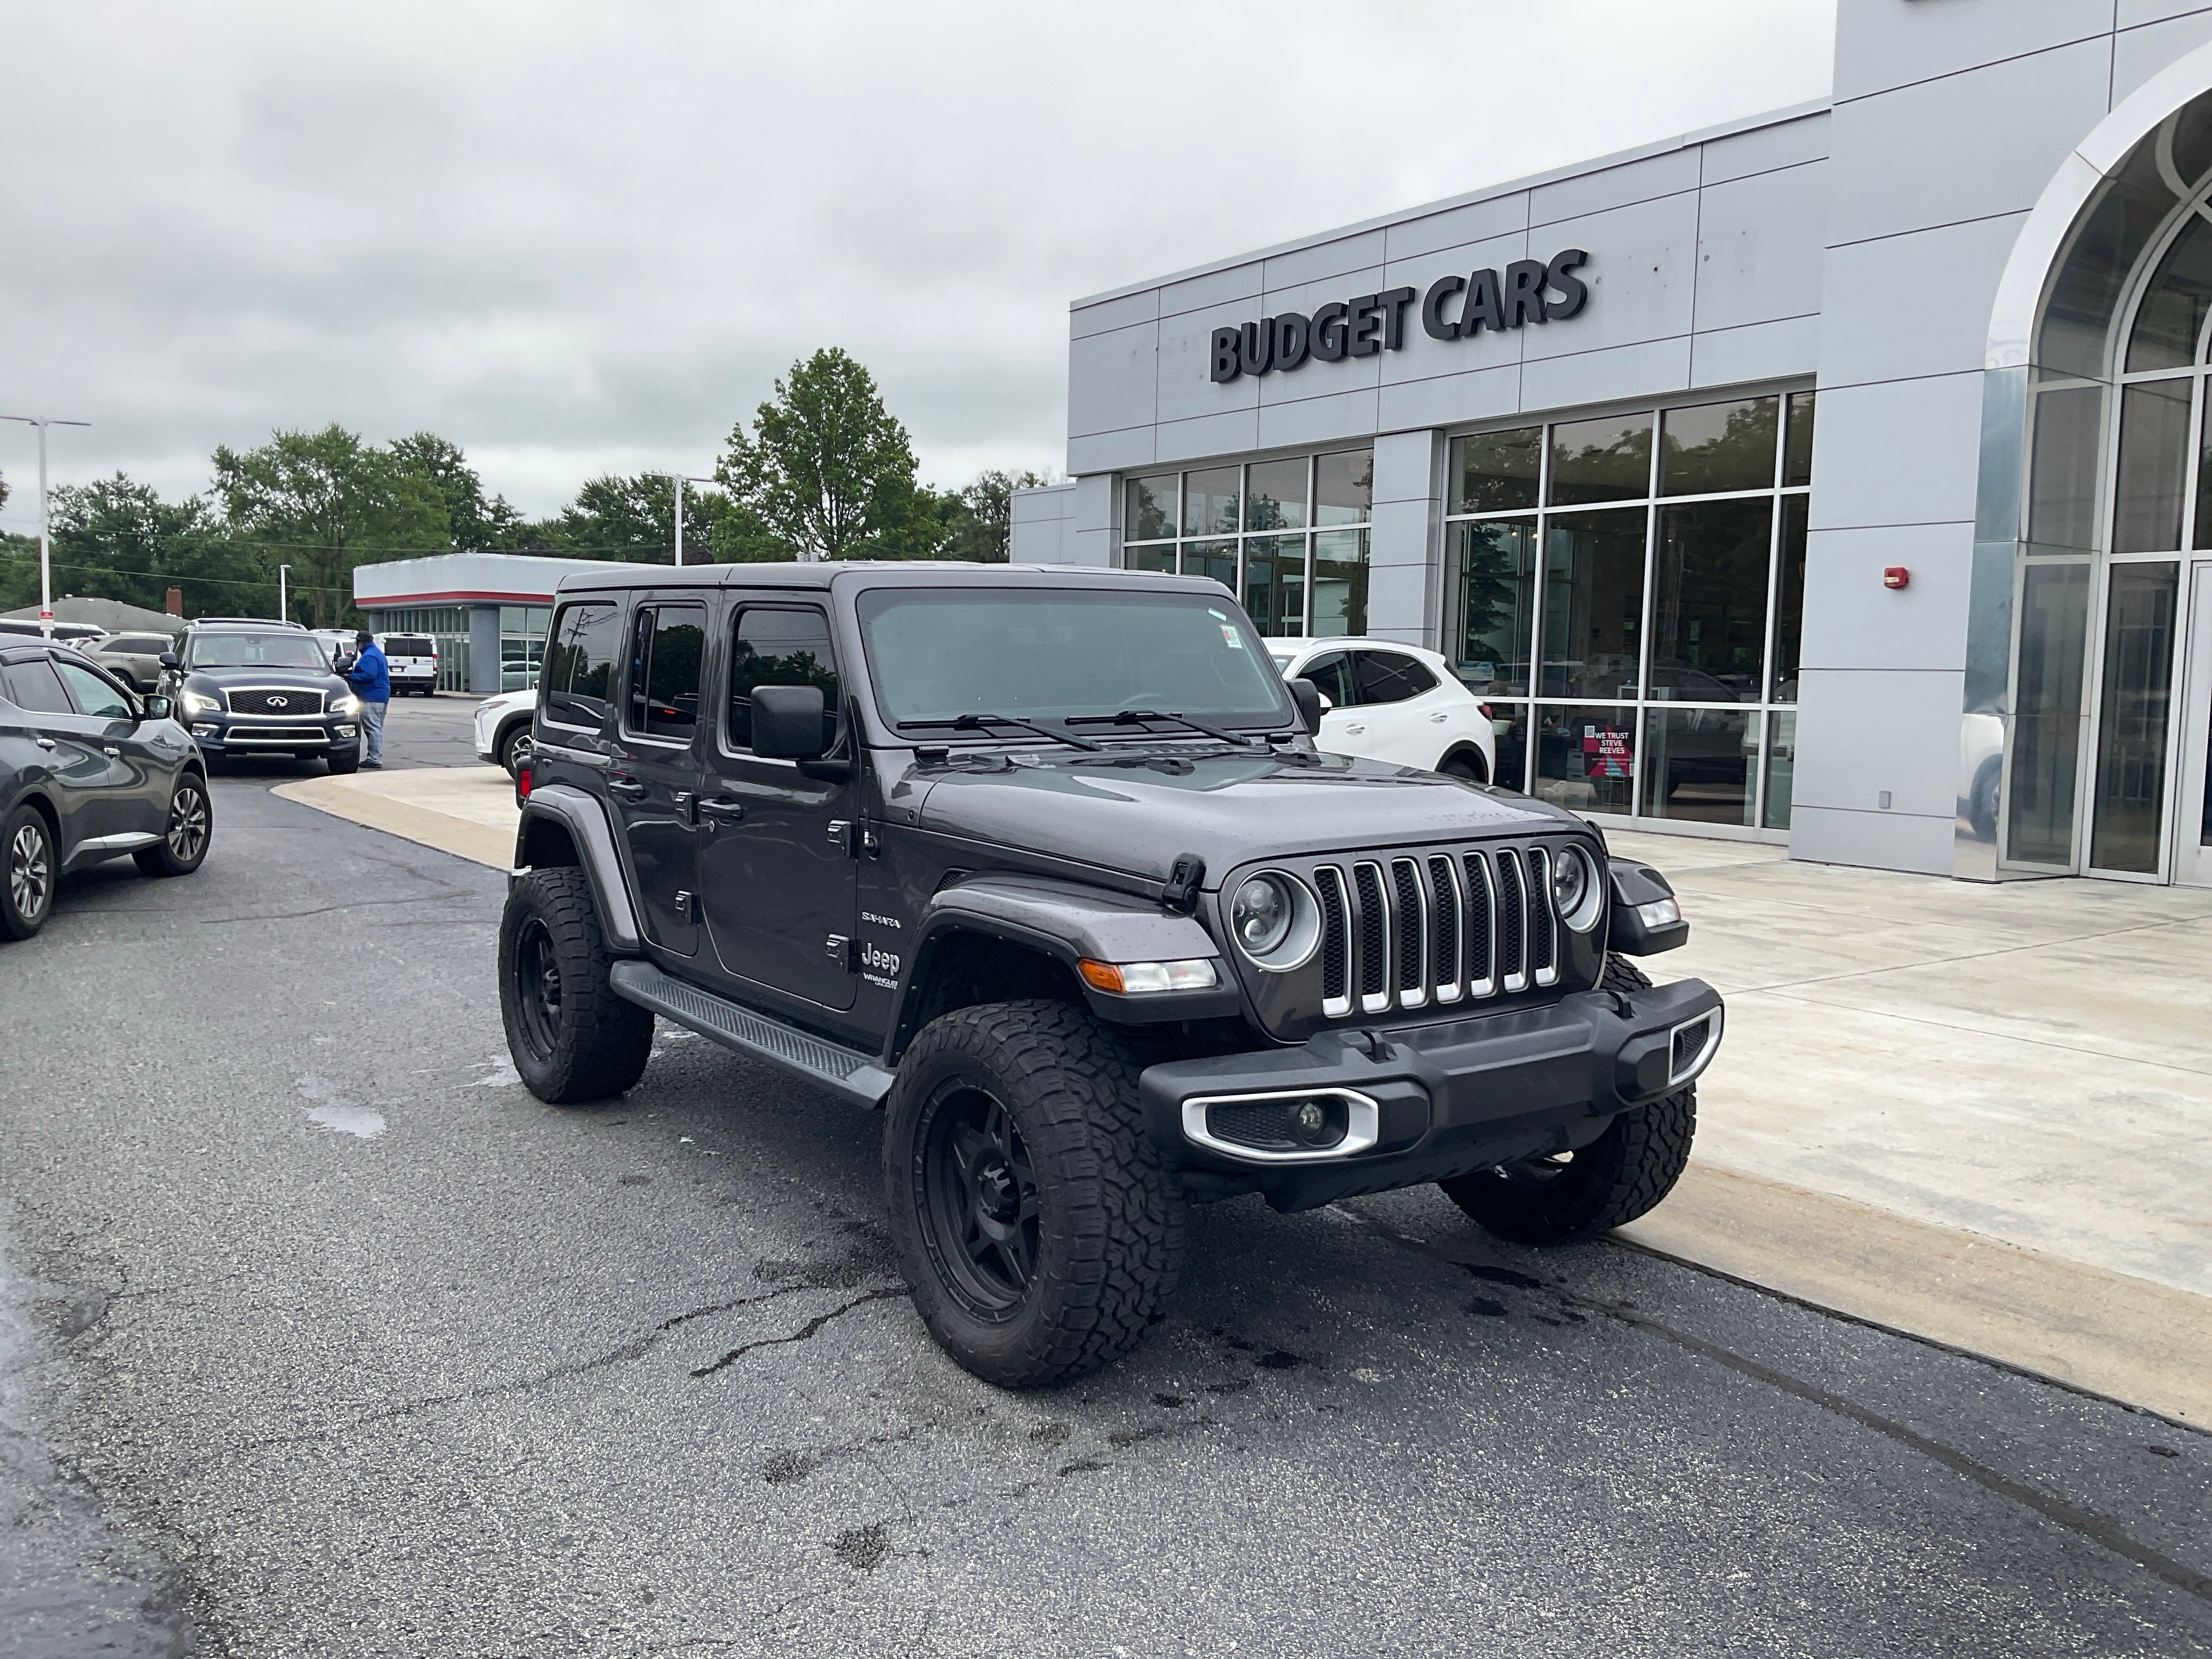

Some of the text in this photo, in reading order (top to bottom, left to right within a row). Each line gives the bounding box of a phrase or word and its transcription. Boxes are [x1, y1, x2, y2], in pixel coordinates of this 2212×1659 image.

[1211, 249, 1588, 382] BUDGET CARS
[862, 912, 901, 928] SAHARA
[862, 943, 900, 976] Jeep
[863, 972, 898, 986] WRANGLE
